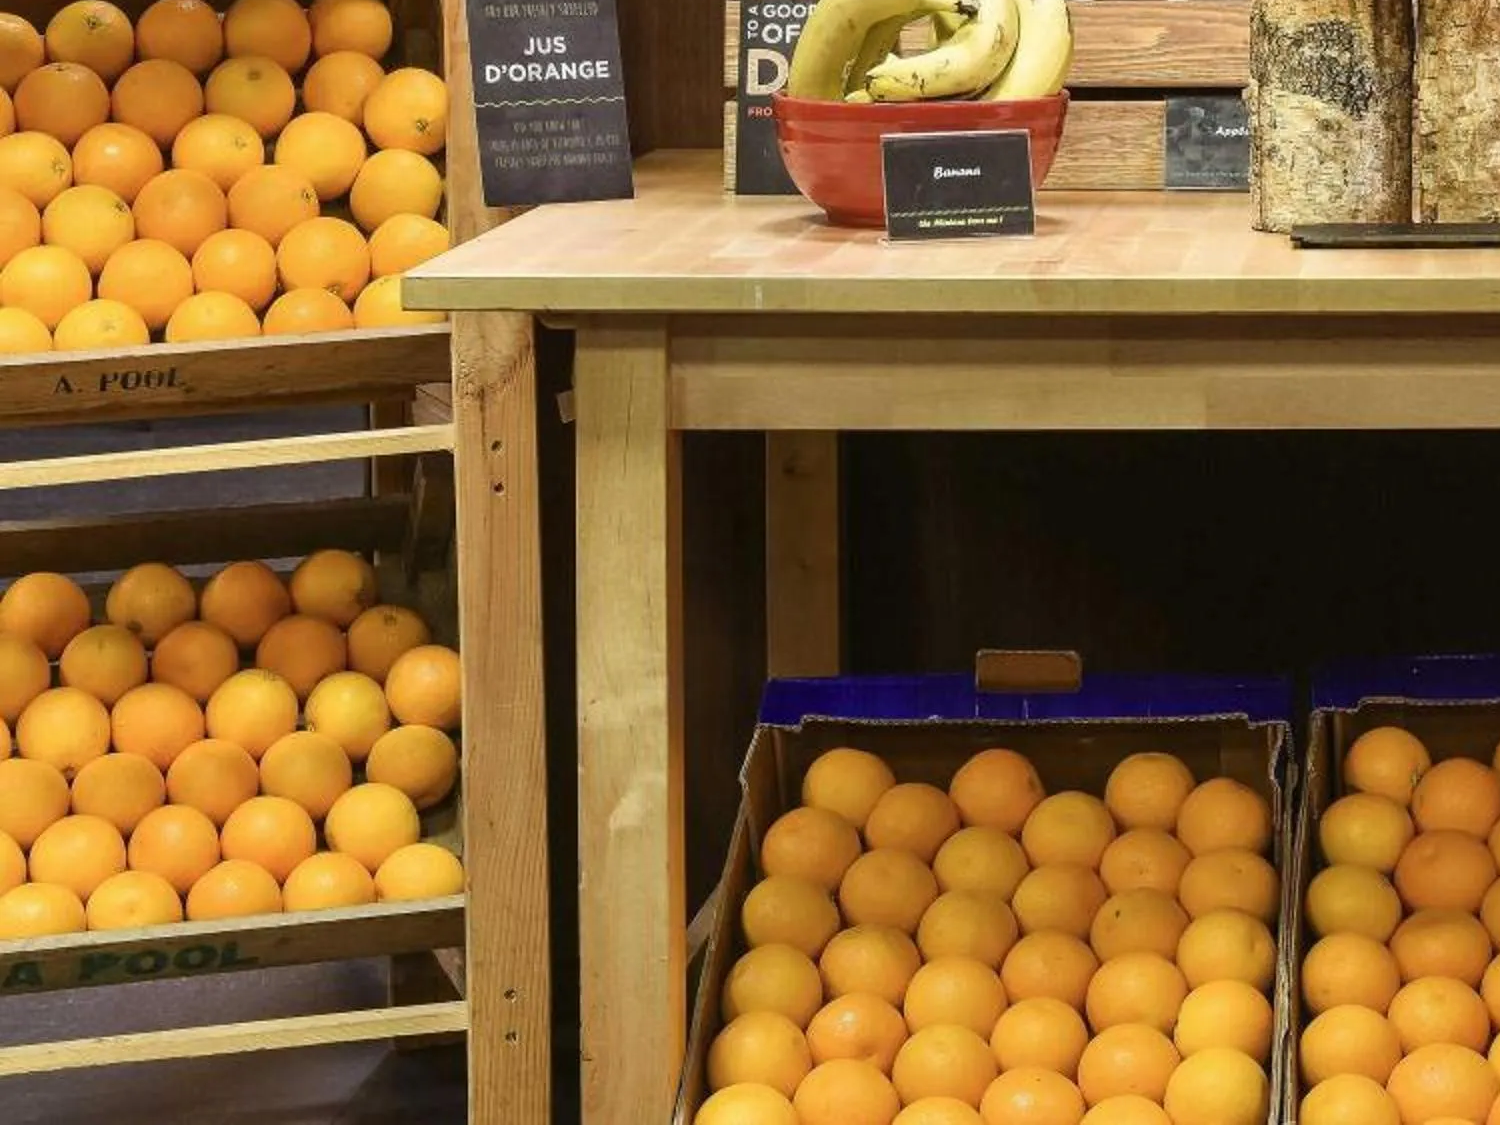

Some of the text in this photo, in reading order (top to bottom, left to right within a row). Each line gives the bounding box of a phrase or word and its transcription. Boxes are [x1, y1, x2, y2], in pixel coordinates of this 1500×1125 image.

[762, 23, 800, 44] OF
[523, 36, 568, 56] JUS
[484, 60, 610, 84] D'ORANGE
[748, 106, 773, 117] FRO
[933, 166, 981, 179] Banana
[79, 943, 260, 980] POOL
